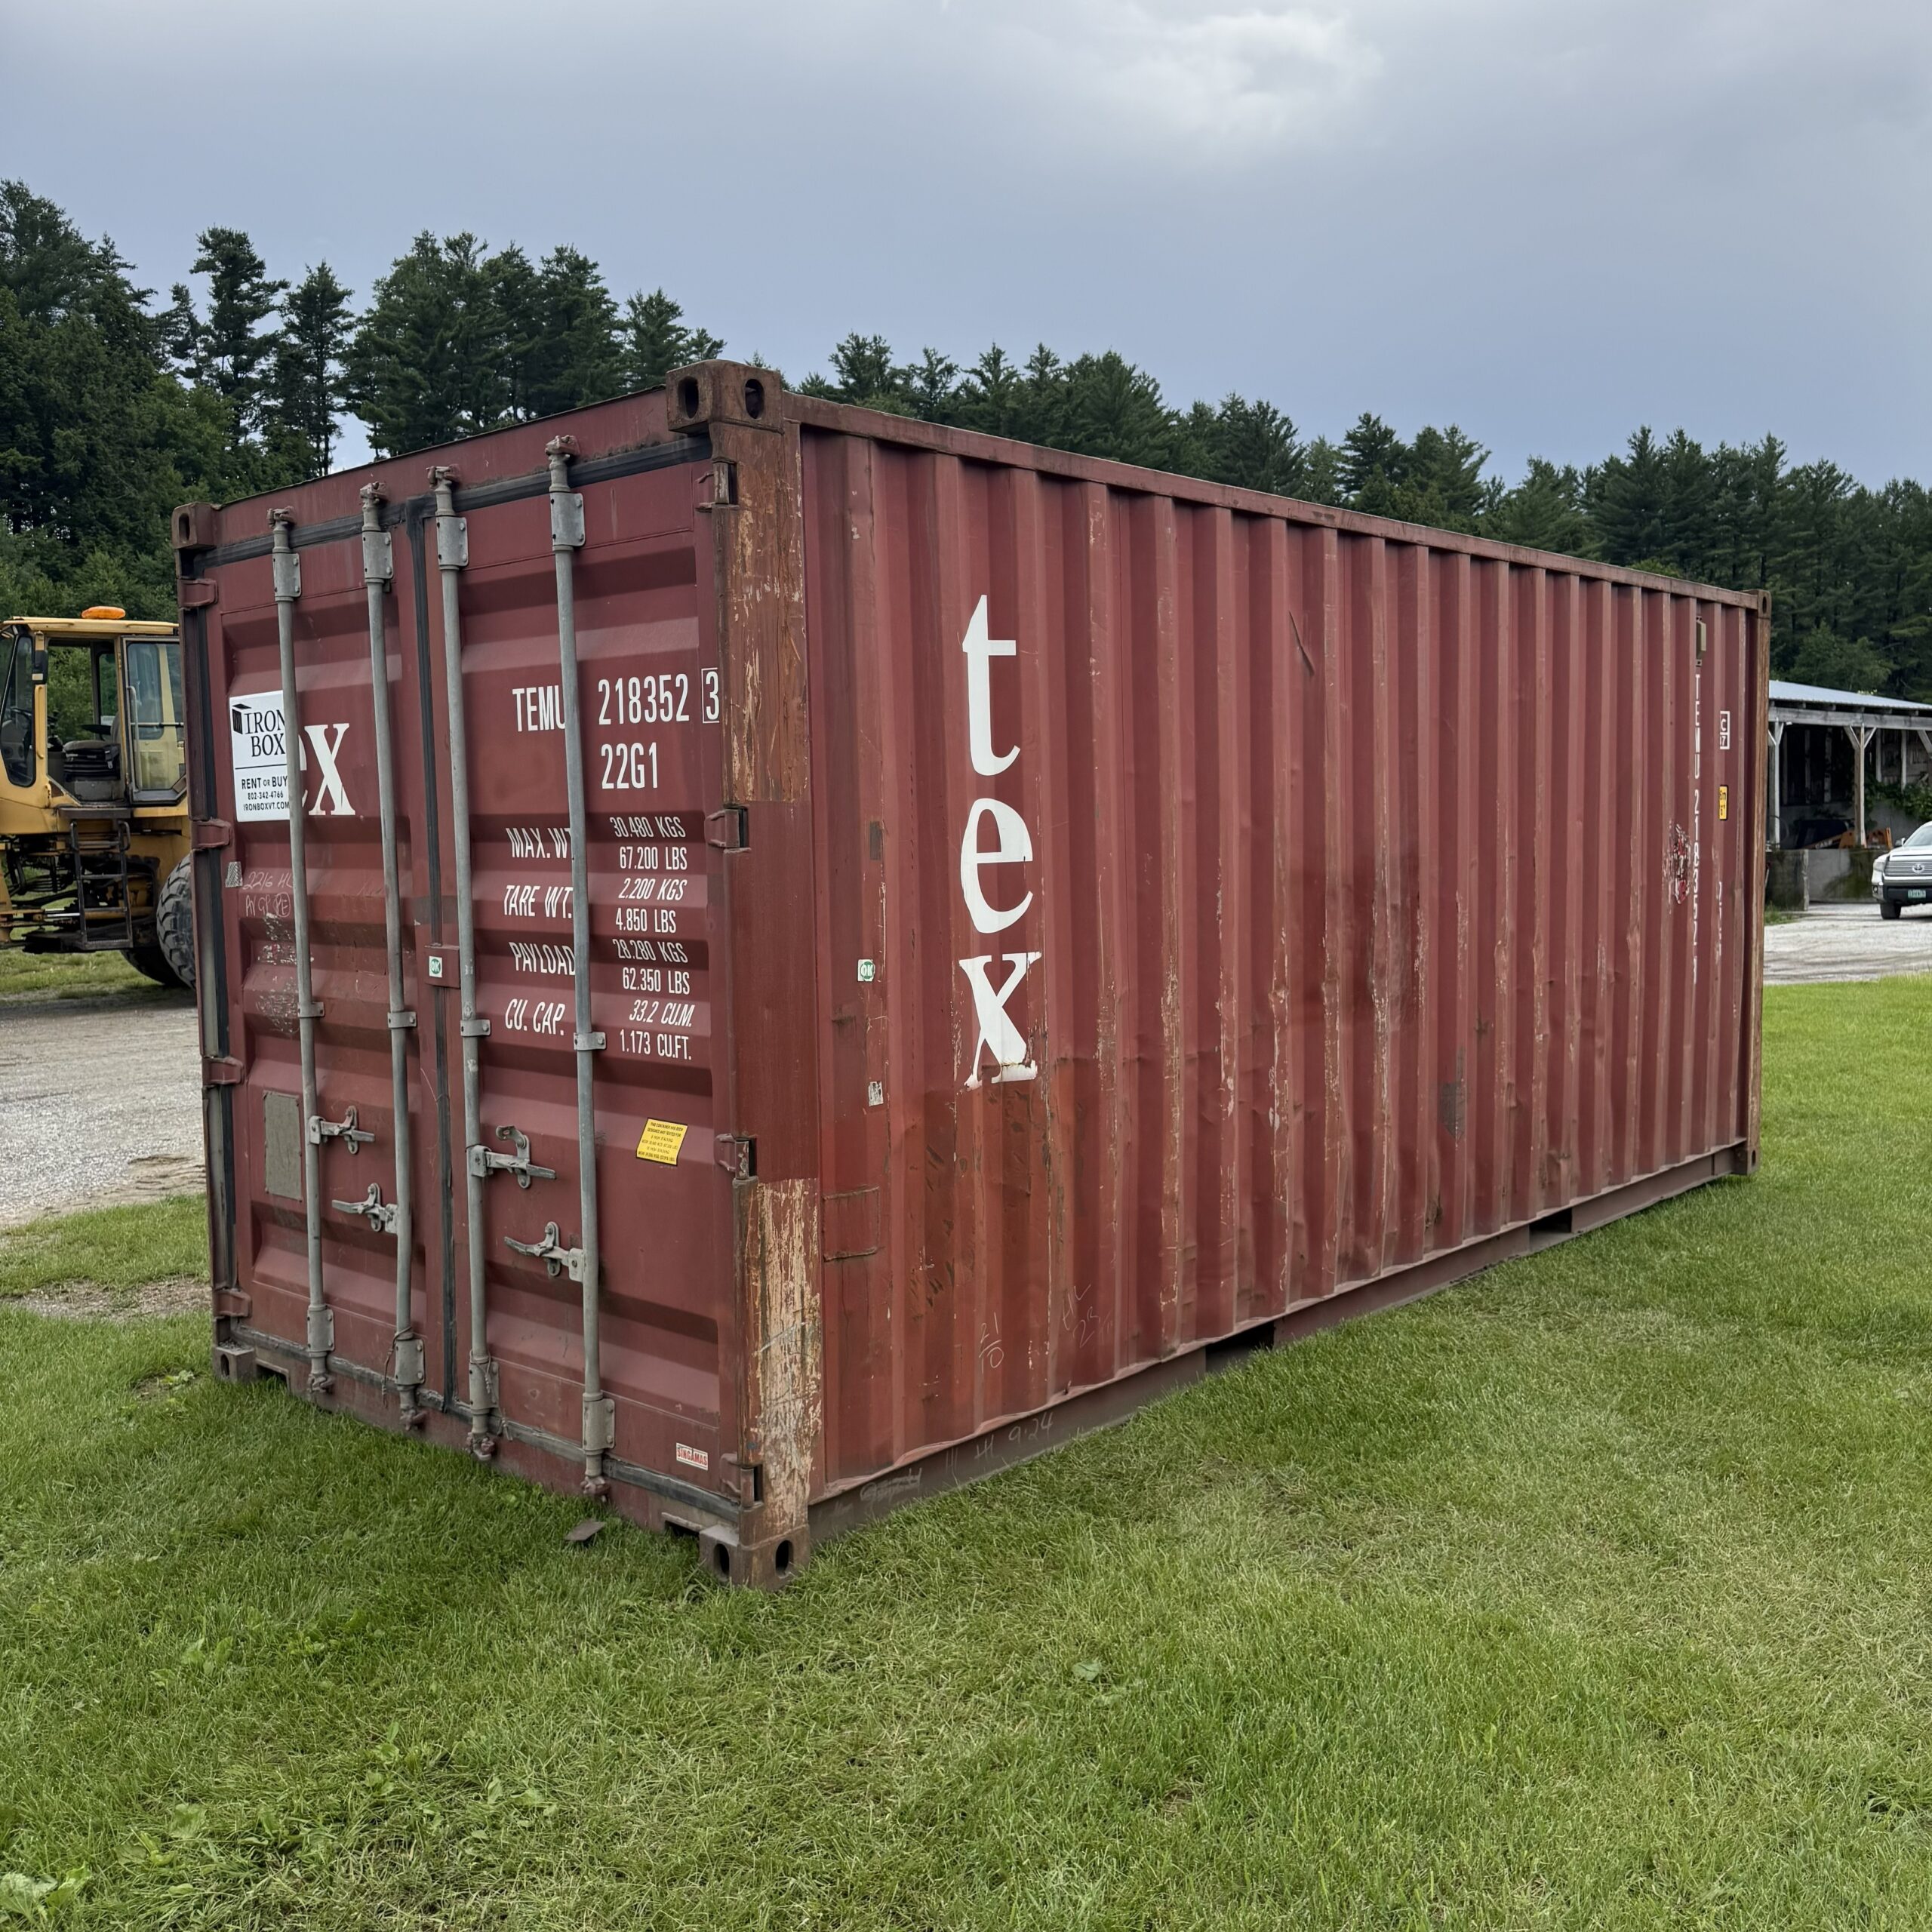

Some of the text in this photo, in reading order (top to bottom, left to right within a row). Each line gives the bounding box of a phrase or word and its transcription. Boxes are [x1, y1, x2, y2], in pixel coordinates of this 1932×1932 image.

[512, 671, 720, 732] TEMU 218352 3
[244, 709, 285, 734] IRON
[251, 733, 285, 757] BOX
[601, 742, 658, 789] 22G1
[242, 778, 261, 789] RENT
[272, 776, 288, 787] BUY
[243, 801, 289, 811] IRONBOXVT.COM
[248, 790, 284, 800] 802-342-4766
[610, 817, 686, 838] 30.480 KGS
[505, 828, 550, 858] MAX.
[959, 595, 1041, 1091] tex
[619, 847, 688, 870] 67.200 LBS
[618, 878, 688, 900] 2.200 KGS
[504, 885, 574, 918] TARE WT.
[654, 909, 676, 933] LBS
[509, 942, 576, 976] PAYLOAD
[612, 939, 688, 964] 28.280 KGS
[431, 960, 440, 972] OK
[860, 964, 872, 977] OK
[668, 970, 690, 995] LBS
[505, 998, 565, 1035] CU. CAP.
[629, 999, 659, 1023] 33.2
[620, 1029, 651, 1054] 1.173
[677, 1447, 707, 1466] SINGAMAS
